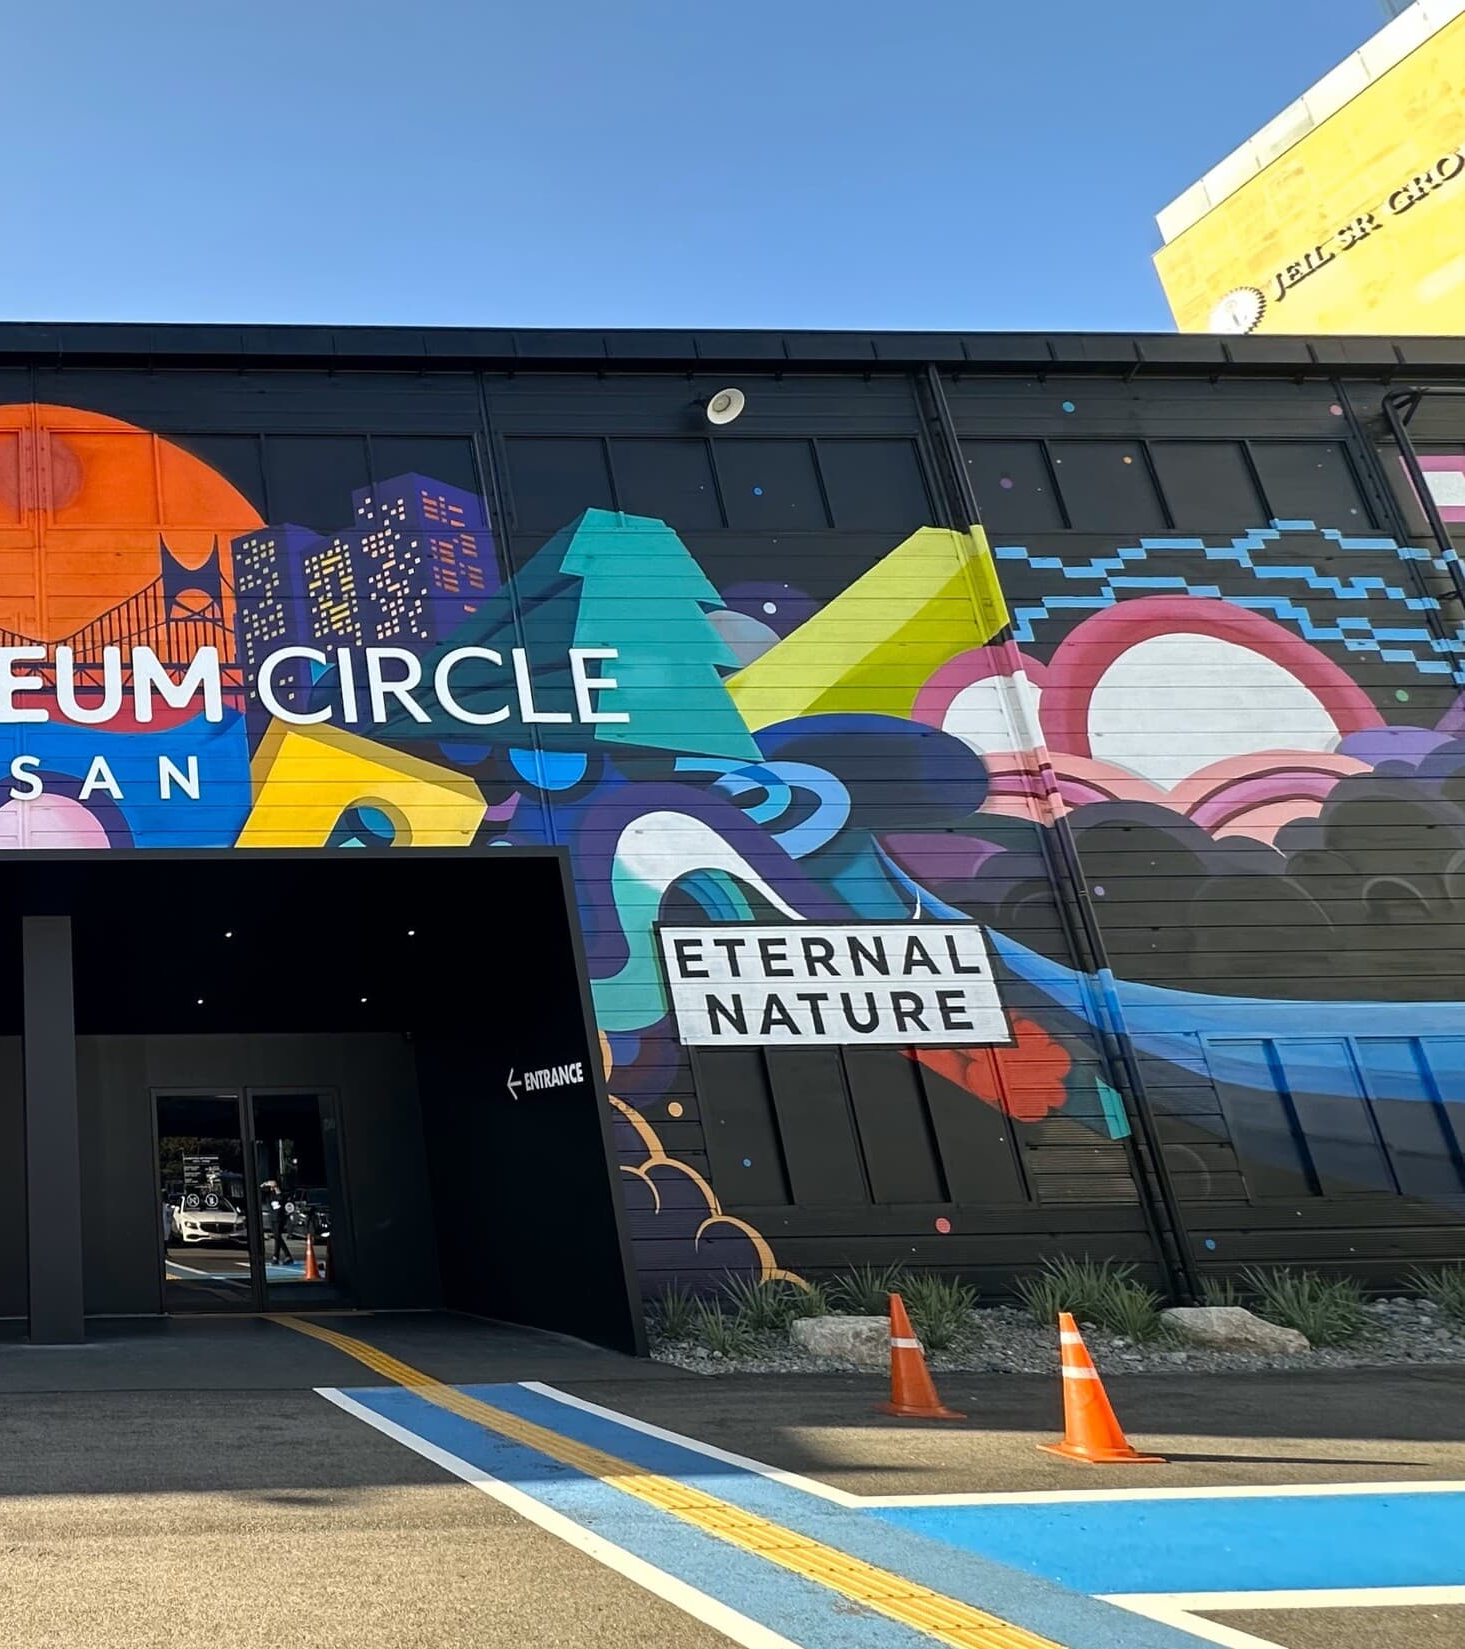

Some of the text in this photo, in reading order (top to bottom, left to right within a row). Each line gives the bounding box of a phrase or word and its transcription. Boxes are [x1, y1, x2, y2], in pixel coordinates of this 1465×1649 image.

[1274, 246, 1335, 302] JEIL
[1336, 212, 1383, 251] SR
[257, 646, 630, 724] CIRCLE
[673, 935, 981, 979] ETERNAL
[705, 990, 974, 1035] NATURE
[524, 1062, 584, 1091] ENTRANCE
